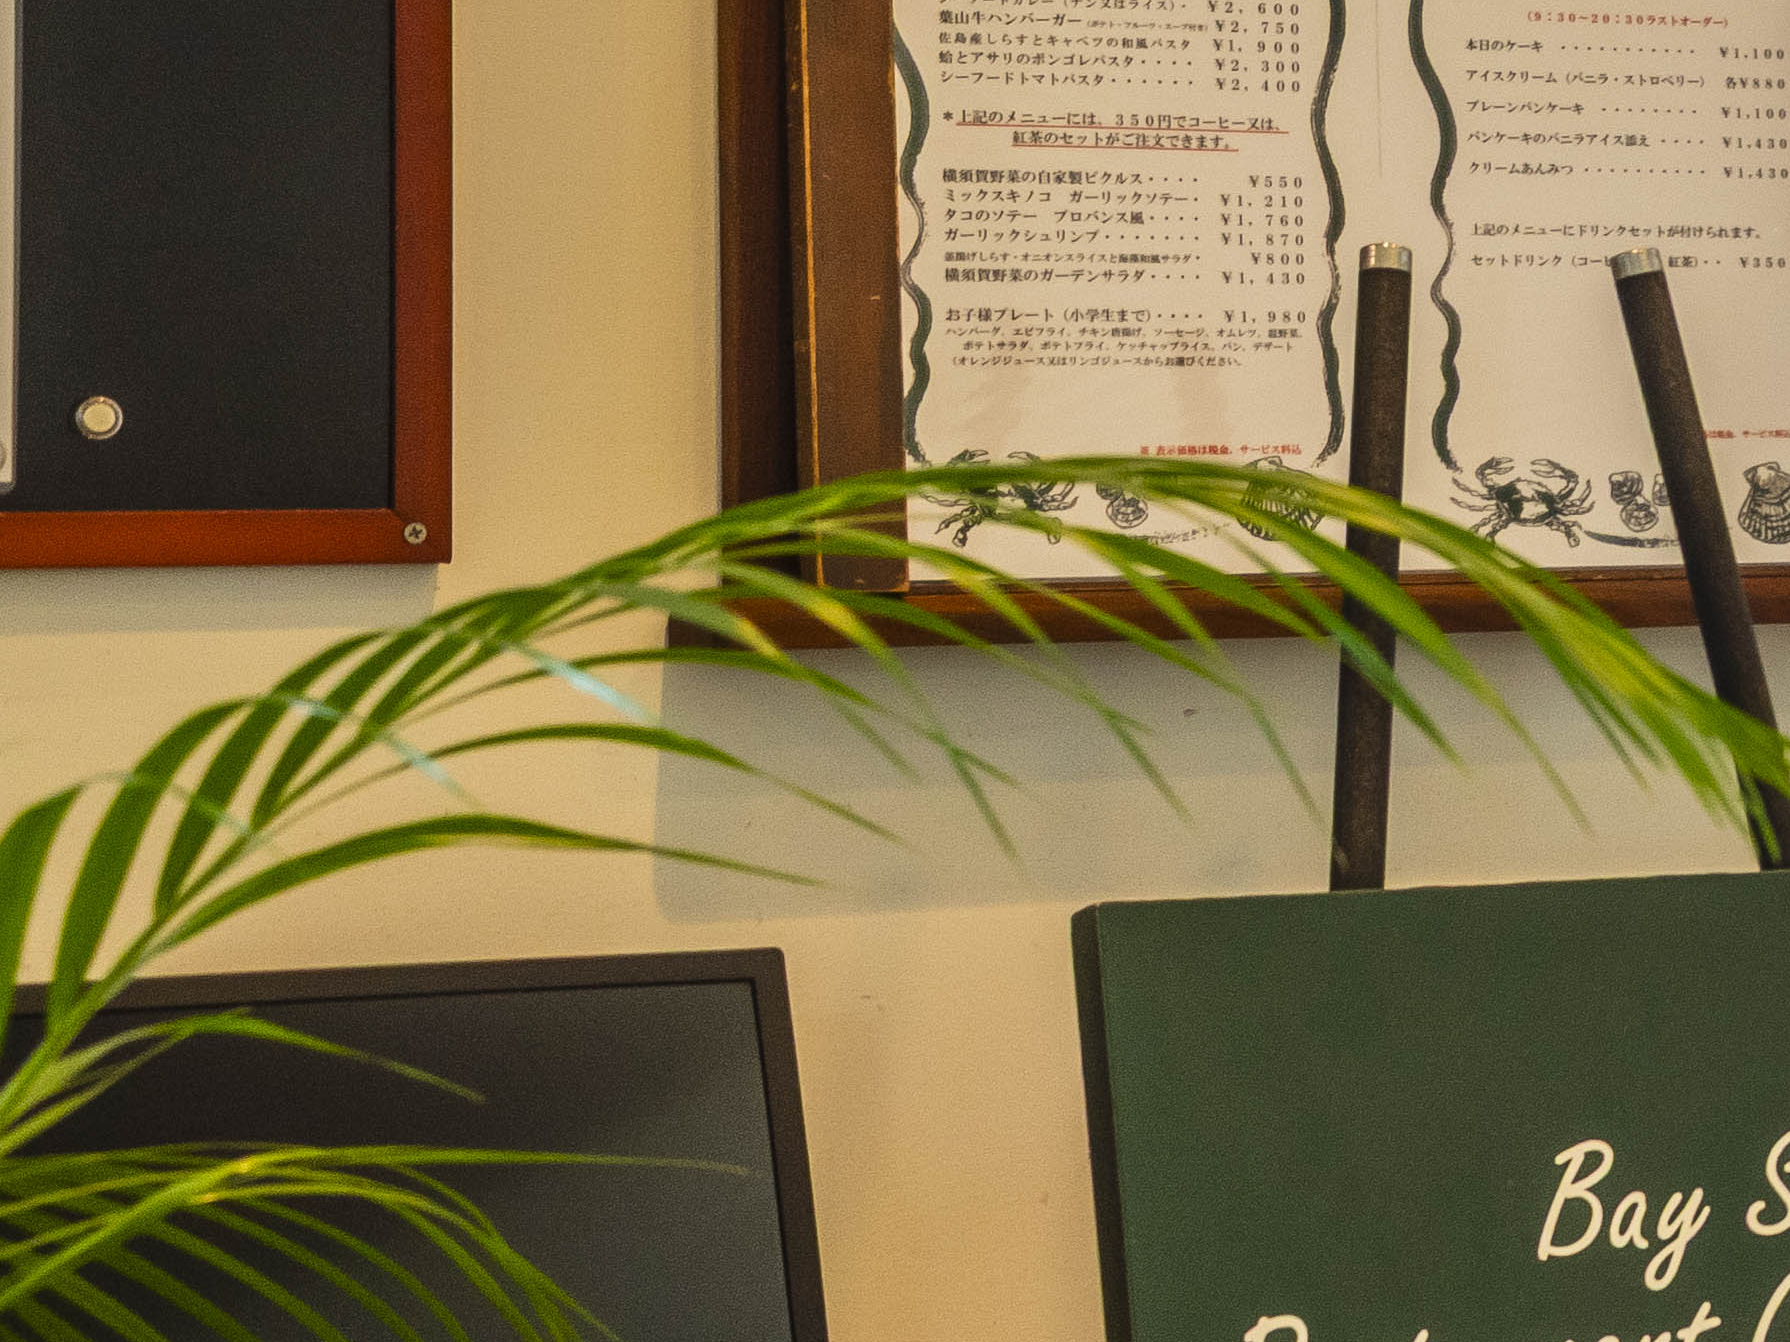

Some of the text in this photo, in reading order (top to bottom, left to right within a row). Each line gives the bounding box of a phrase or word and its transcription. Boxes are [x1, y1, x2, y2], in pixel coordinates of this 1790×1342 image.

[939, 10, 1082, 27] 葉山牛ハンバーガー
[1465, 39, 1544, 53] 本日のケーキ
[1469, 161, 1573, 176] クリームあんみつ
[1536, 1139, 1711, 1292] Bay
